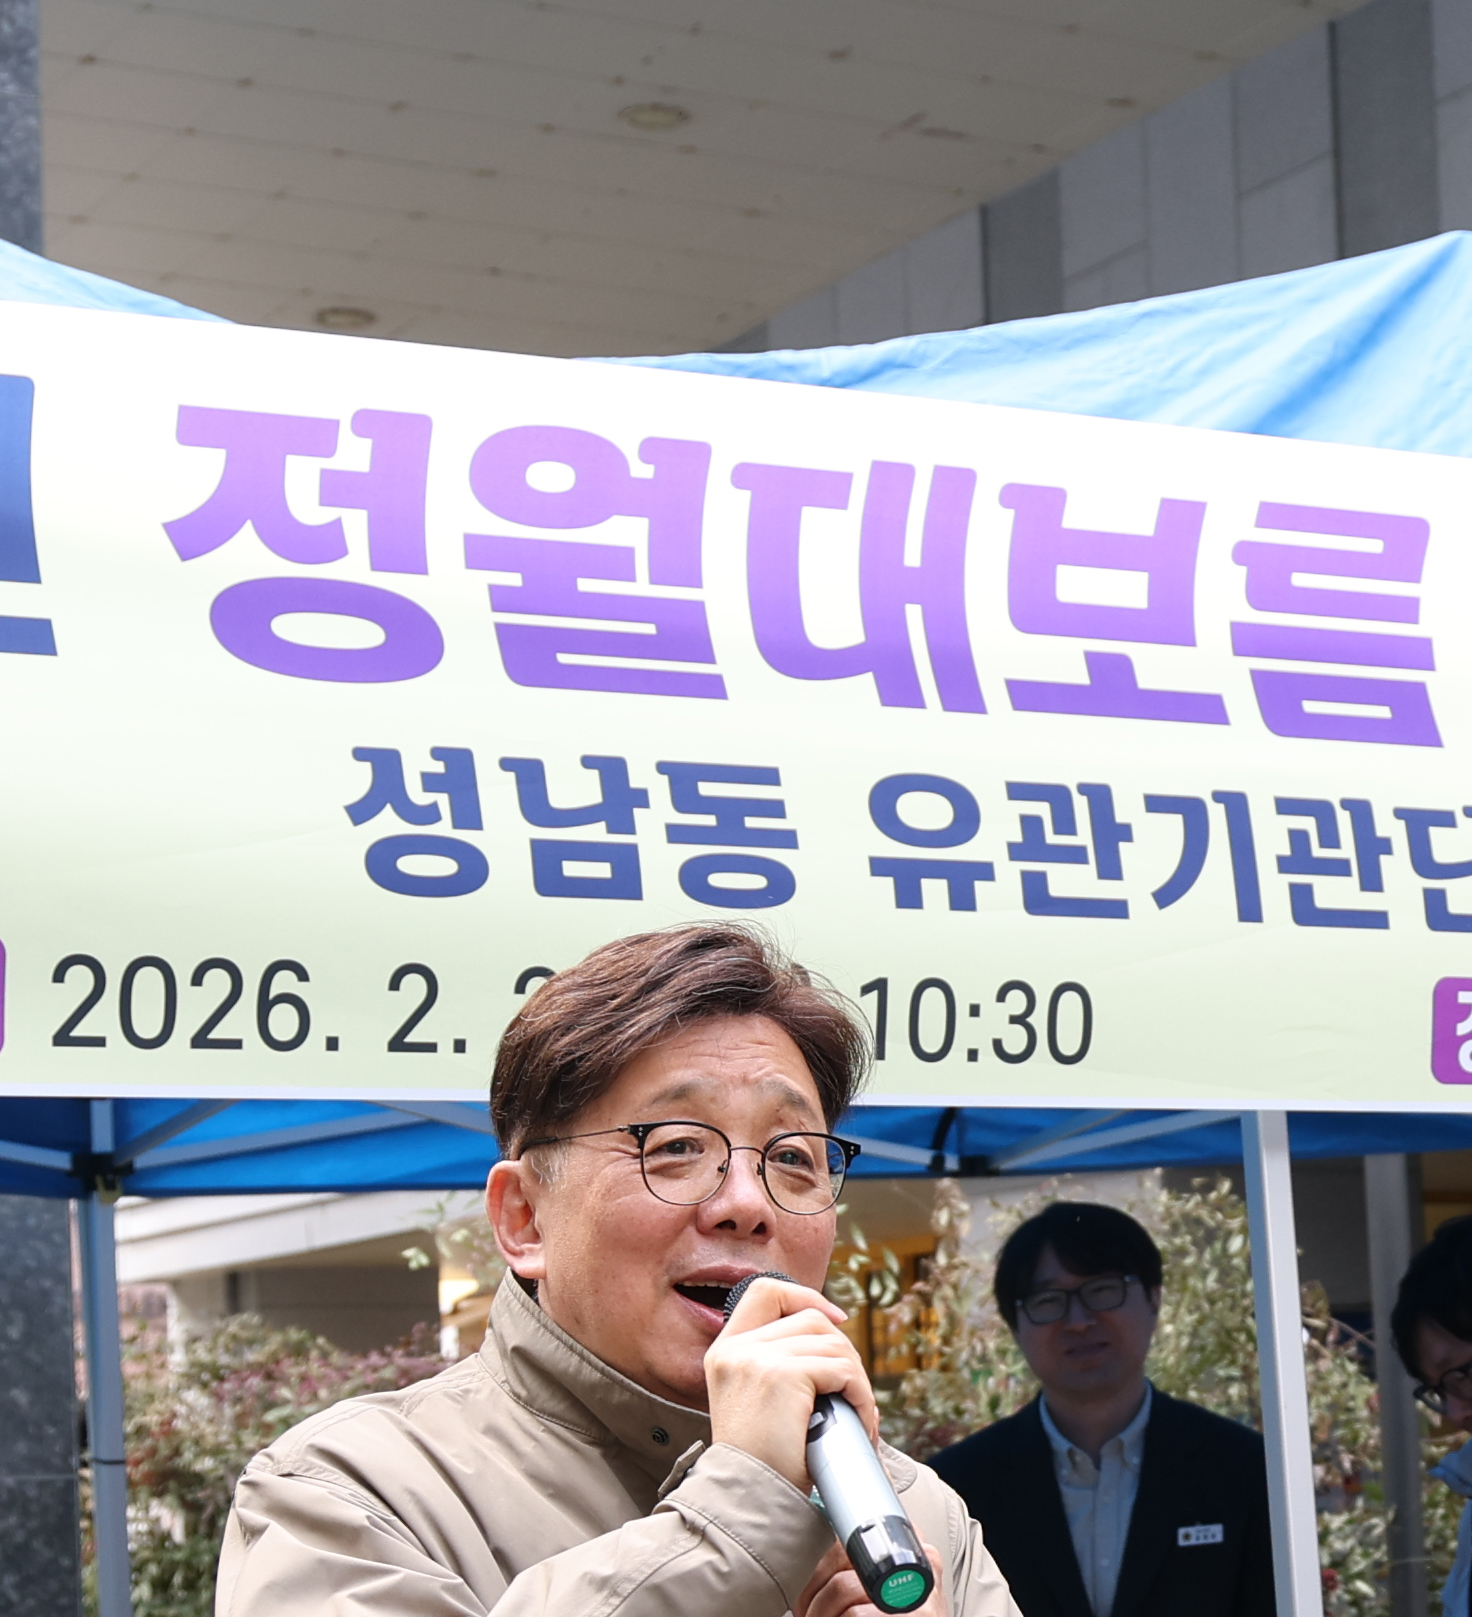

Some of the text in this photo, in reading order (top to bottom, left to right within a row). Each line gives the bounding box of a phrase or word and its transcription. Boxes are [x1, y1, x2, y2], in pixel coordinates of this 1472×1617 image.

[162, 404, 1445, 748] 정월대보름
[345, 746, 799, 910] 성남동
[52, 953, 468, 1054] 2026. 2.
[859, 976, 1093, 1066] 10:30
[888, 1573, 915, 1587] UHF
